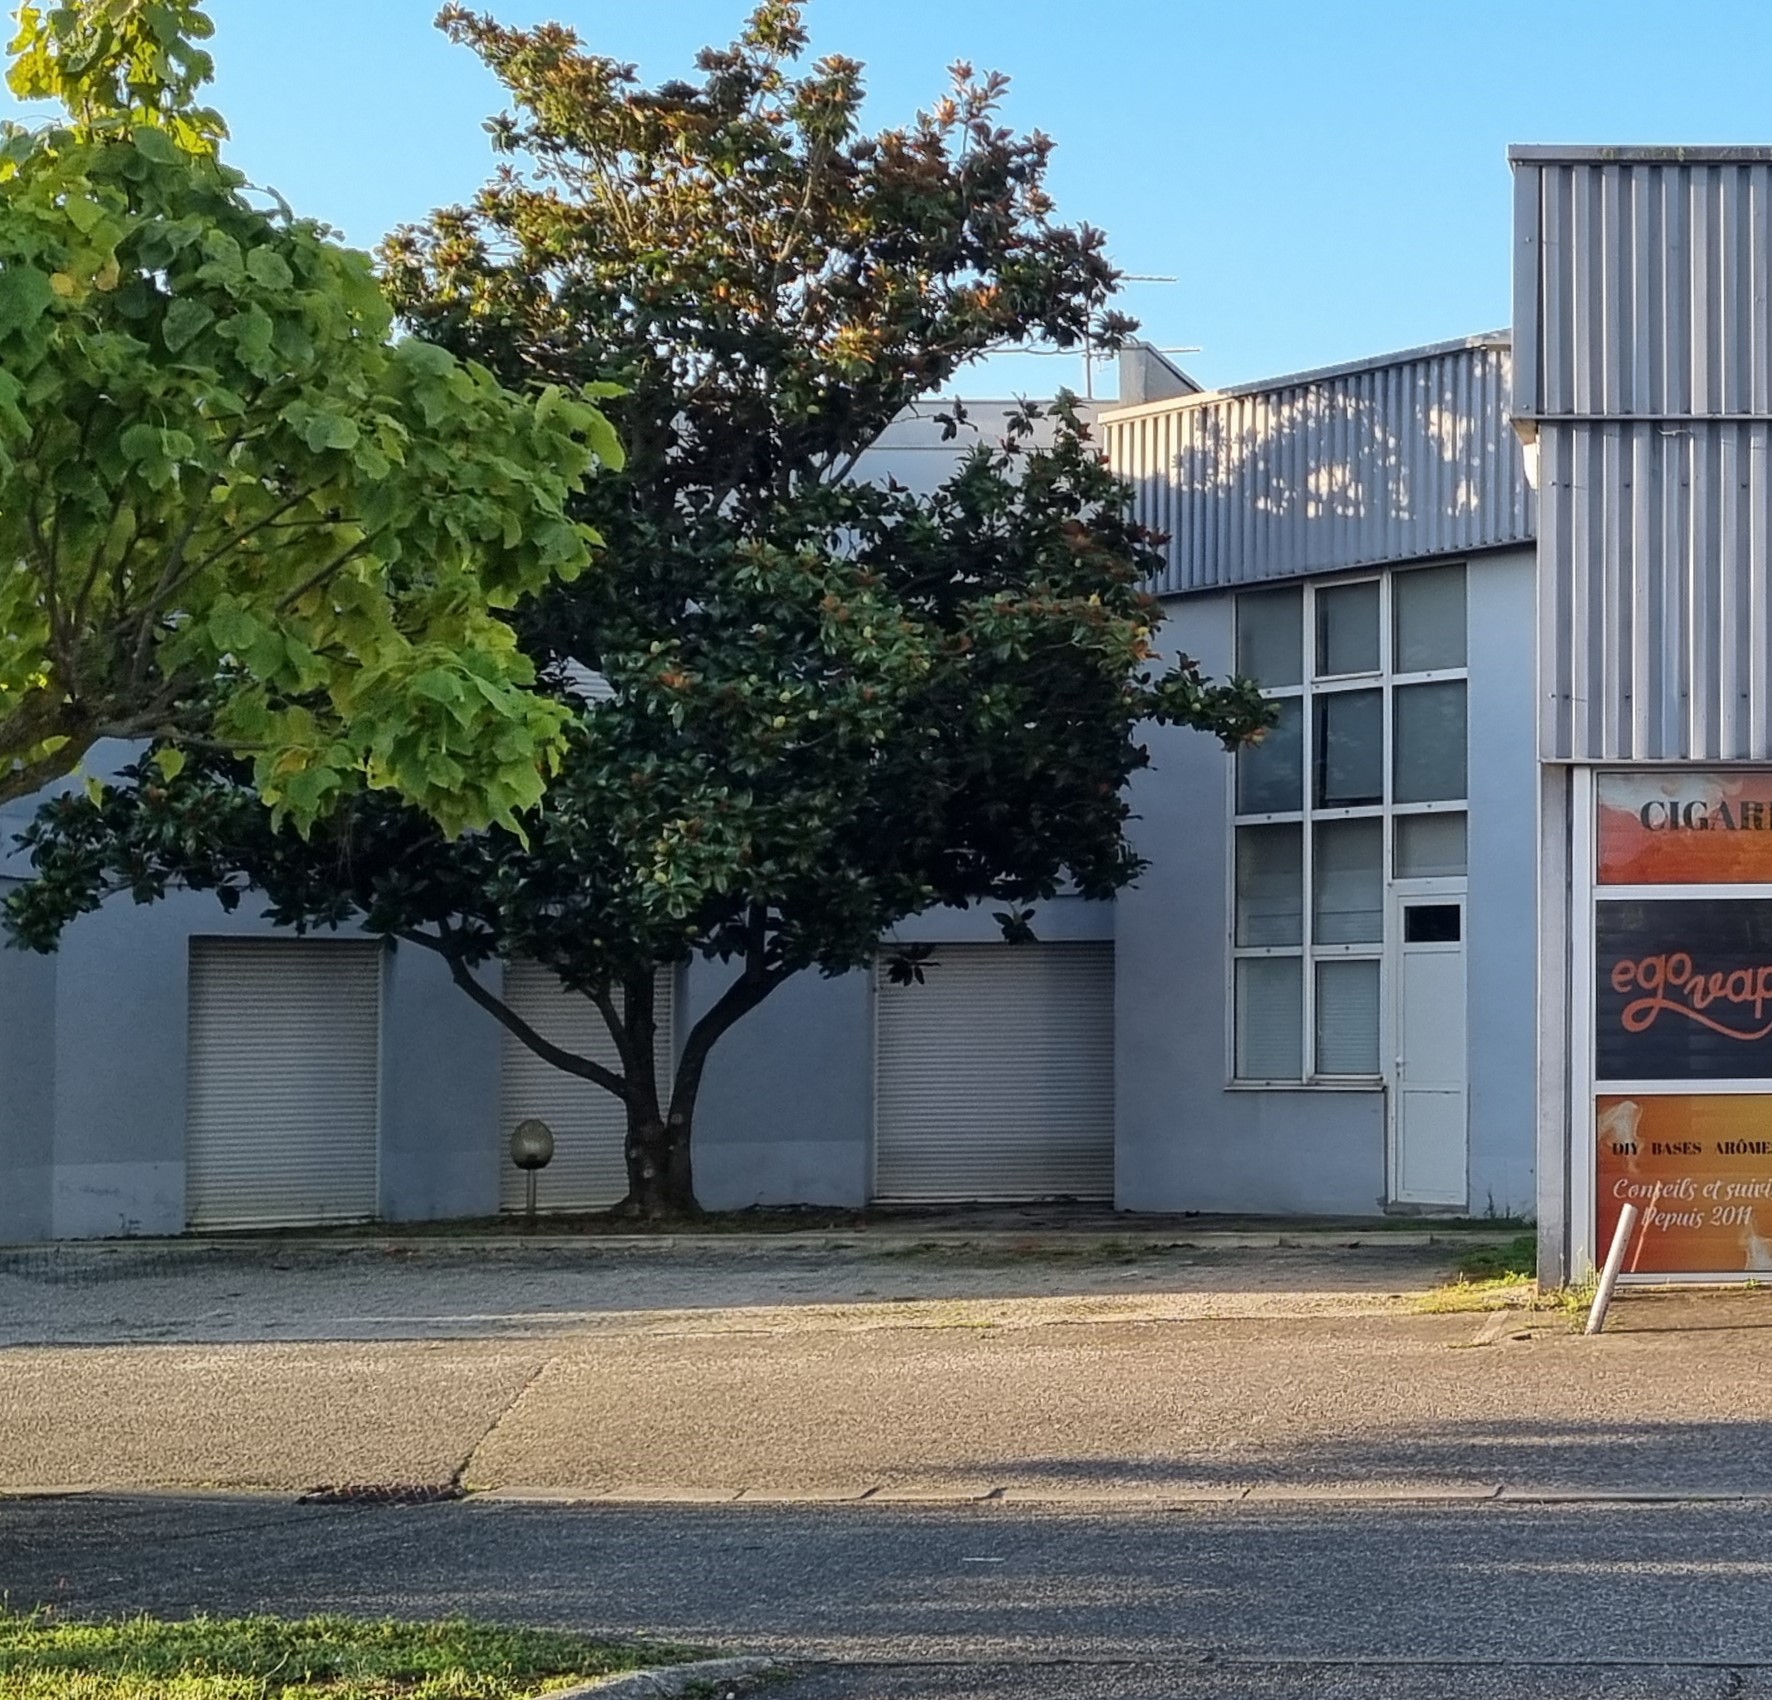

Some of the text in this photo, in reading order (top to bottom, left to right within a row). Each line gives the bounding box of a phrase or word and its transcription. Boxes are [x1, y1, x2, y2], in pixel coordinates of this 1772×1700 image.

[1612, 1142, 1639, 1156] DIY
[1651, 1141, 1702, 1156] BASES
[1613, 1178, 1698, 1200] Conseils
[1702, 1180, 1720, 1200] et
[1641, 1204, 1752, 1232] Depuis 2011
